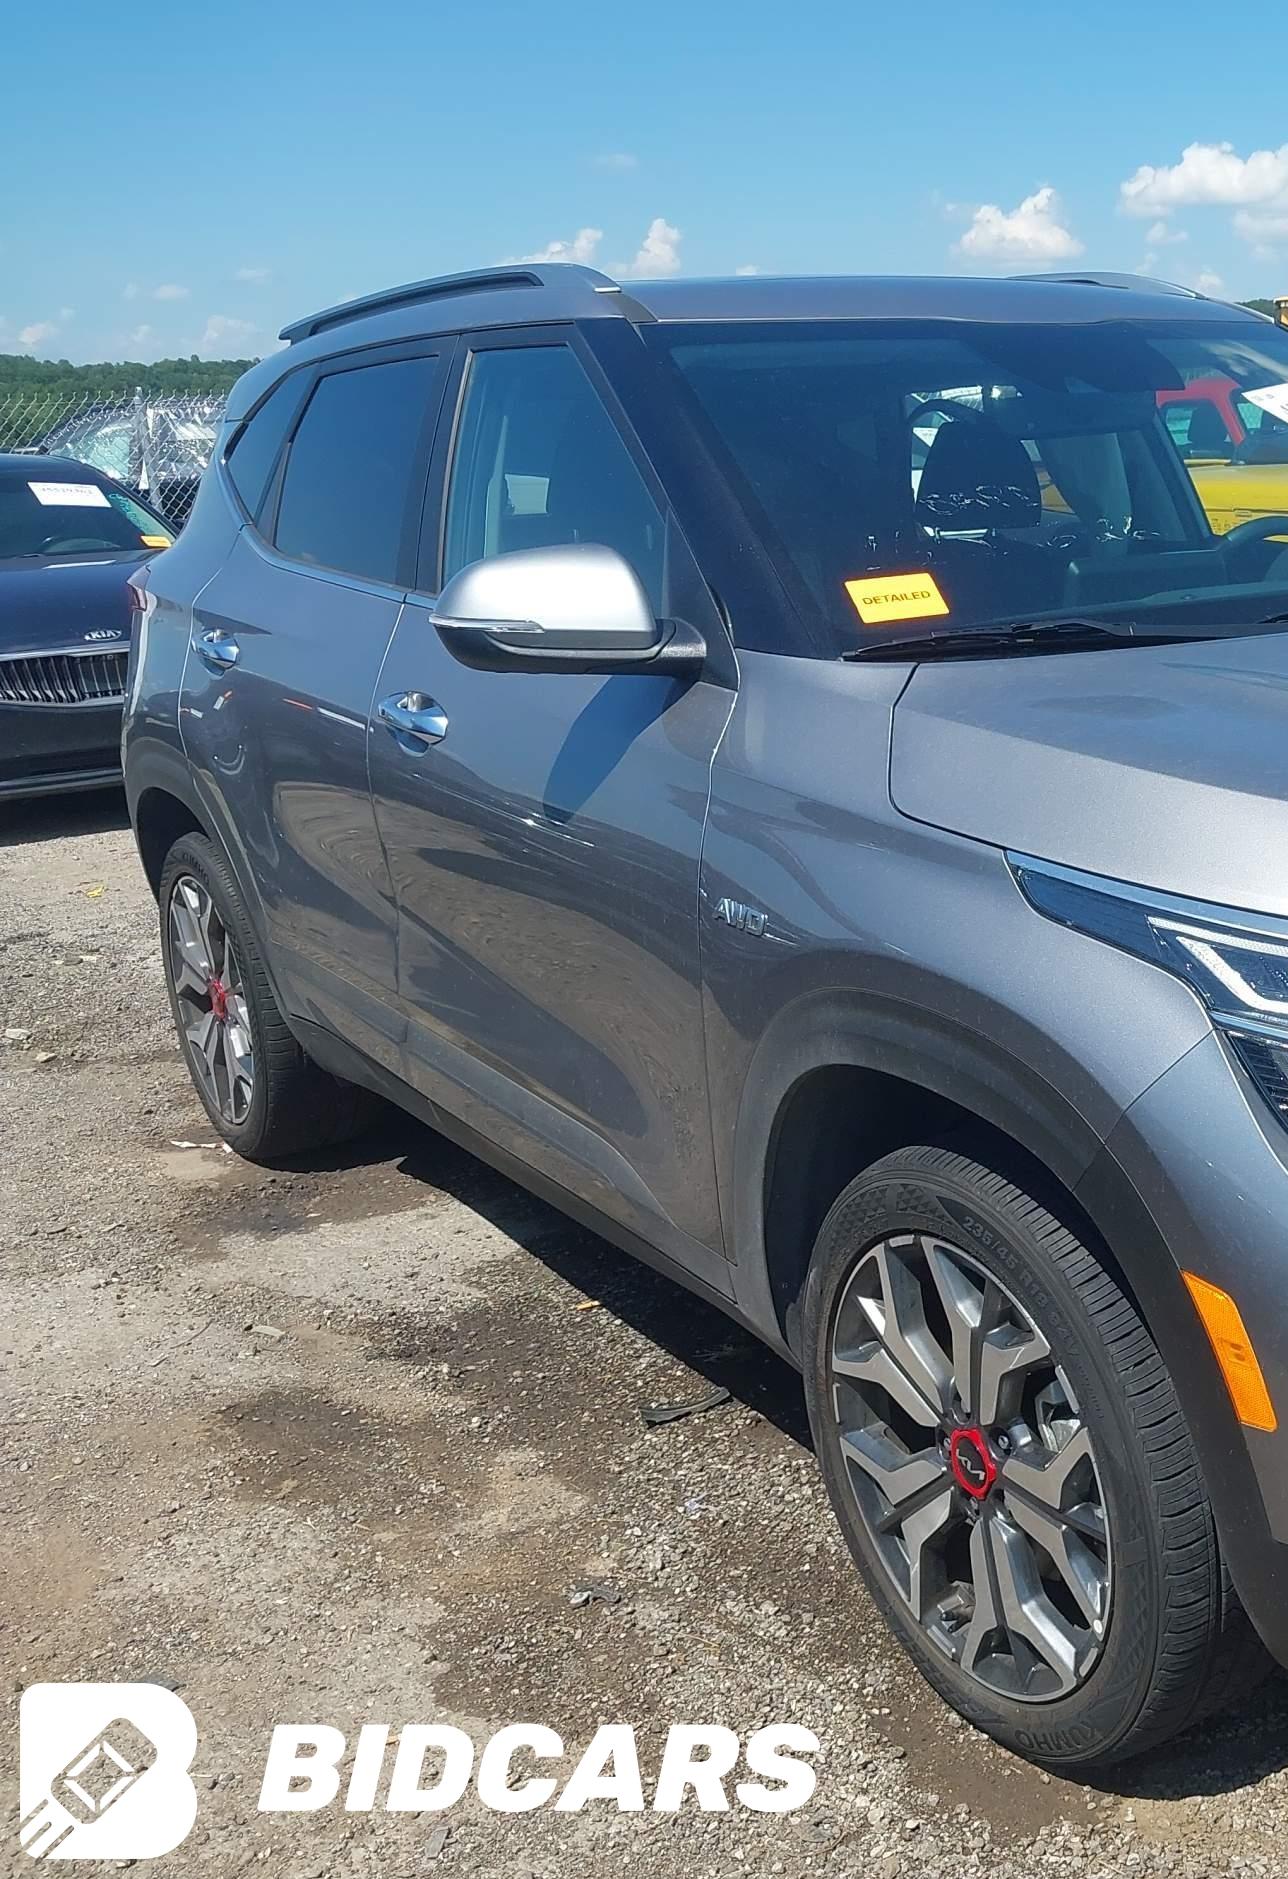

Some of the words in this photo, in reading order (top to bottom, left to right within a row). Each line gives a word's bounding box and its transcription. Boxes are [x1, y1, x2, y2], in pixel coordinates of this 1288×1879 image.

[862, 590, 931, 605] DETAILED
[88, 629, 119, 641] KIA
[712, 897, 767, 936] AWD
[961, 1215, 1017, 1271] 235/45
[1014, 1720, 1098, 1751] KUMHO
